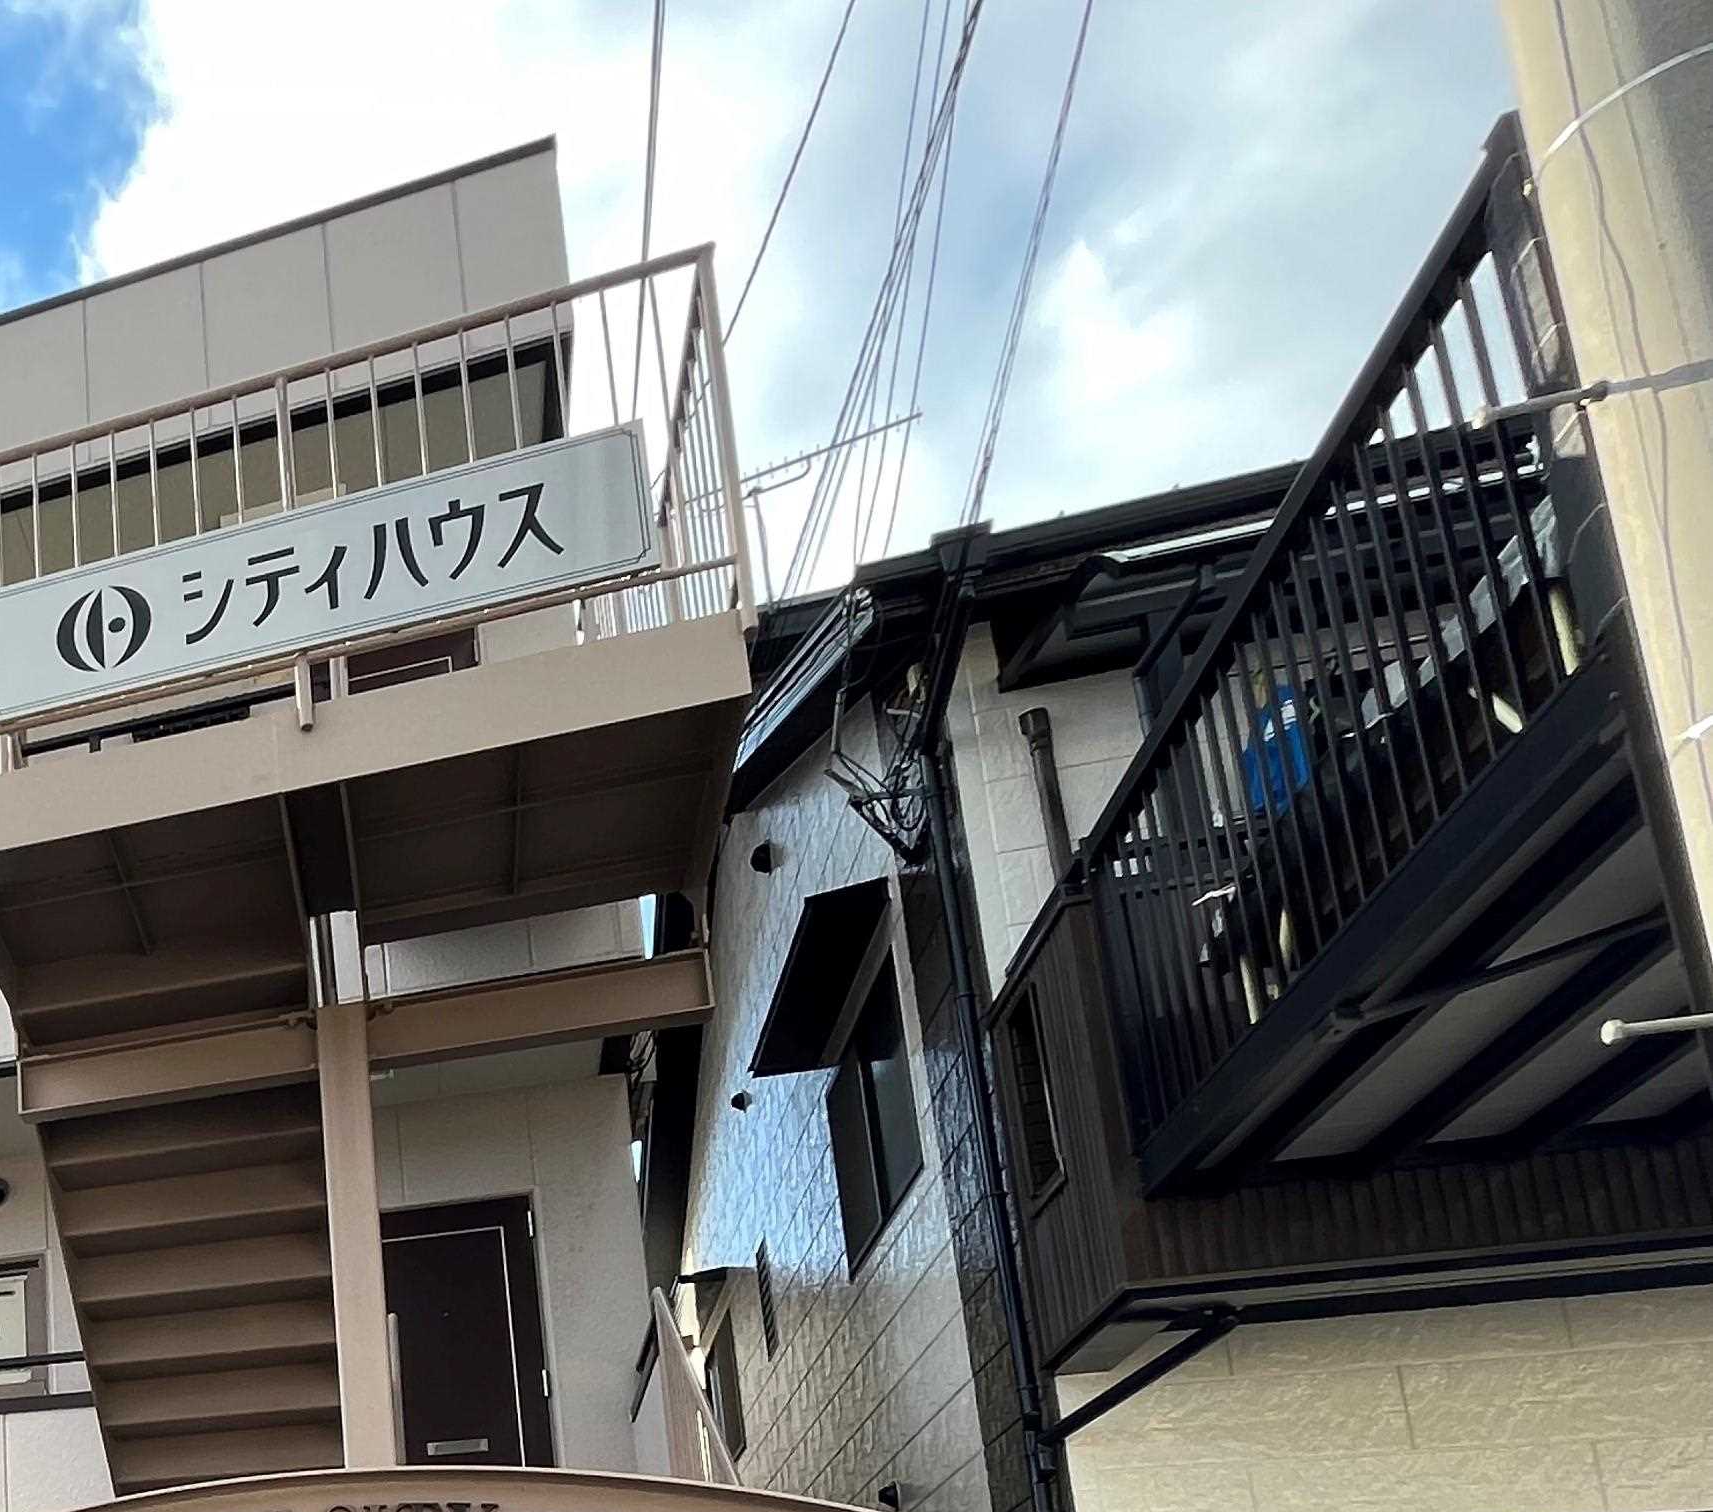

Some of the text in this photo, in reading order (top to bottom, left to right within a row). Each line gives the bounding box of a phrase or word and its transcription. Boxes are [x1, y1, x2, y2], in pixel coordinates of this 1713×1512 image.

[182, 482, 564, 645] シティハウス
